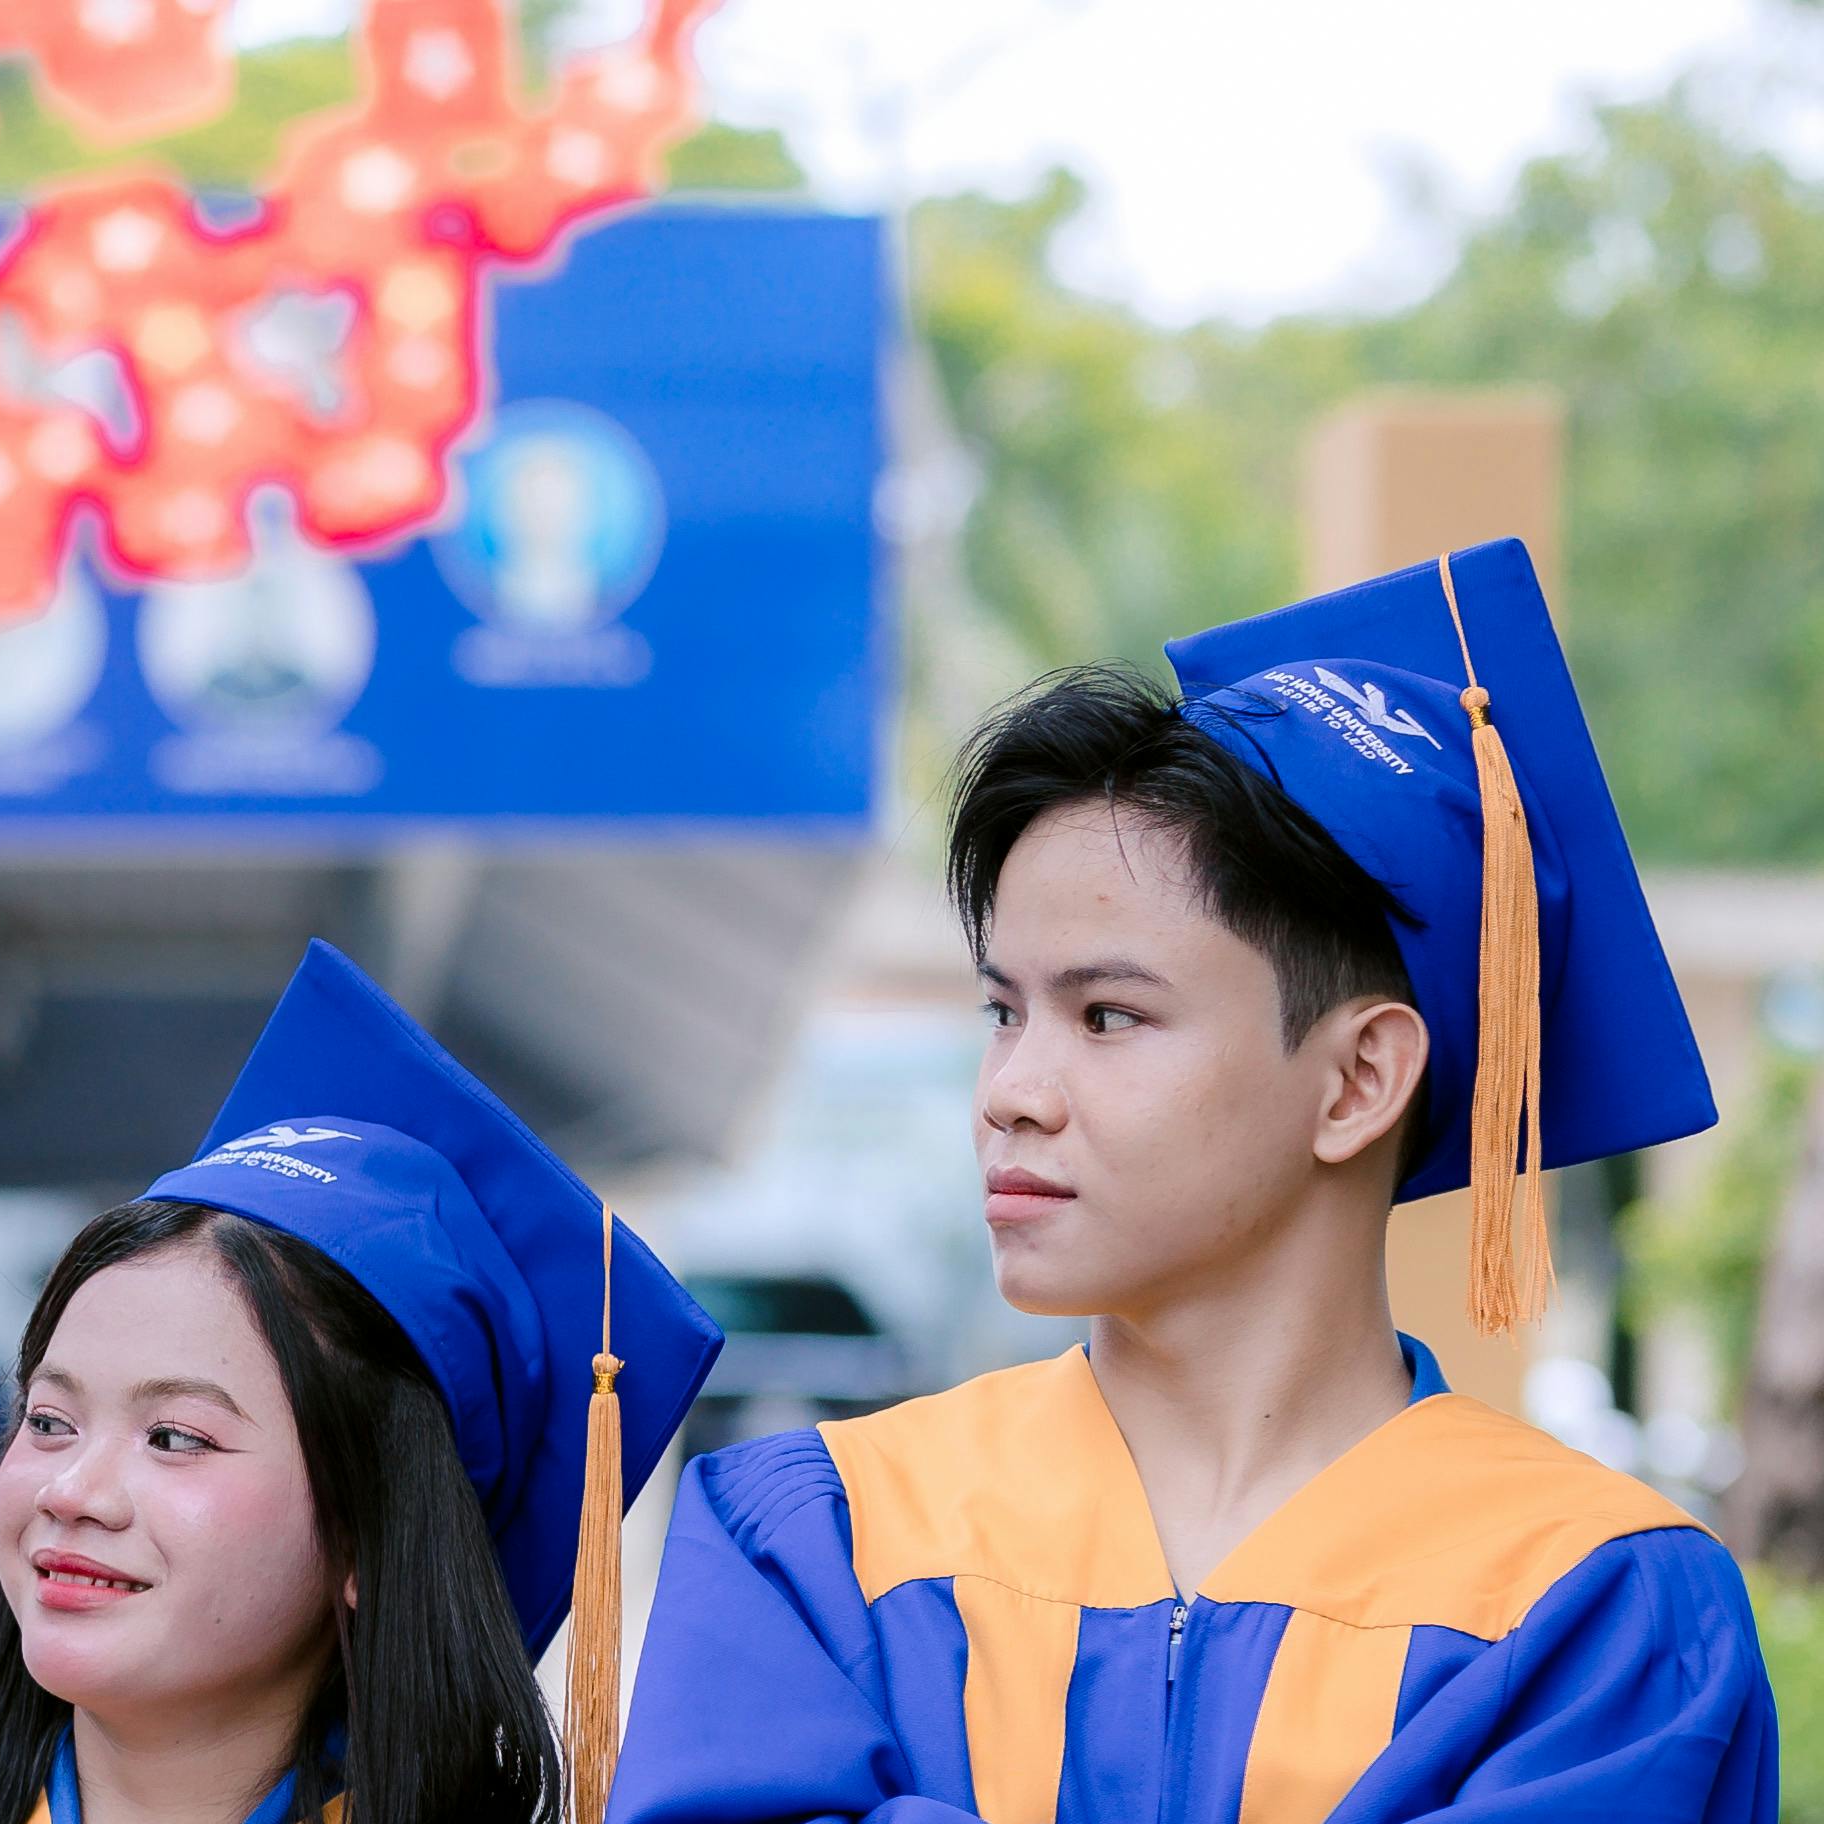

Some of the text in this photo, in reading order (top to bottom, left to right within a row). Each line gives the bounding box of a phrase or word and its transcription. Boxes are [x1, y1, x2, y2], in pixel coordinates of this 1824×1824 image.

[1263, 671, 1414, 775] LAC HONG UNIVERSITY
[1272, 685, 1376, 760] ASPIRE TO LEAD
[240, 1158, 259, 1167] TO
[261, 1162, 300, 1178] LEAD
[247, 1150, 337, 1184] UNIVERSITY
